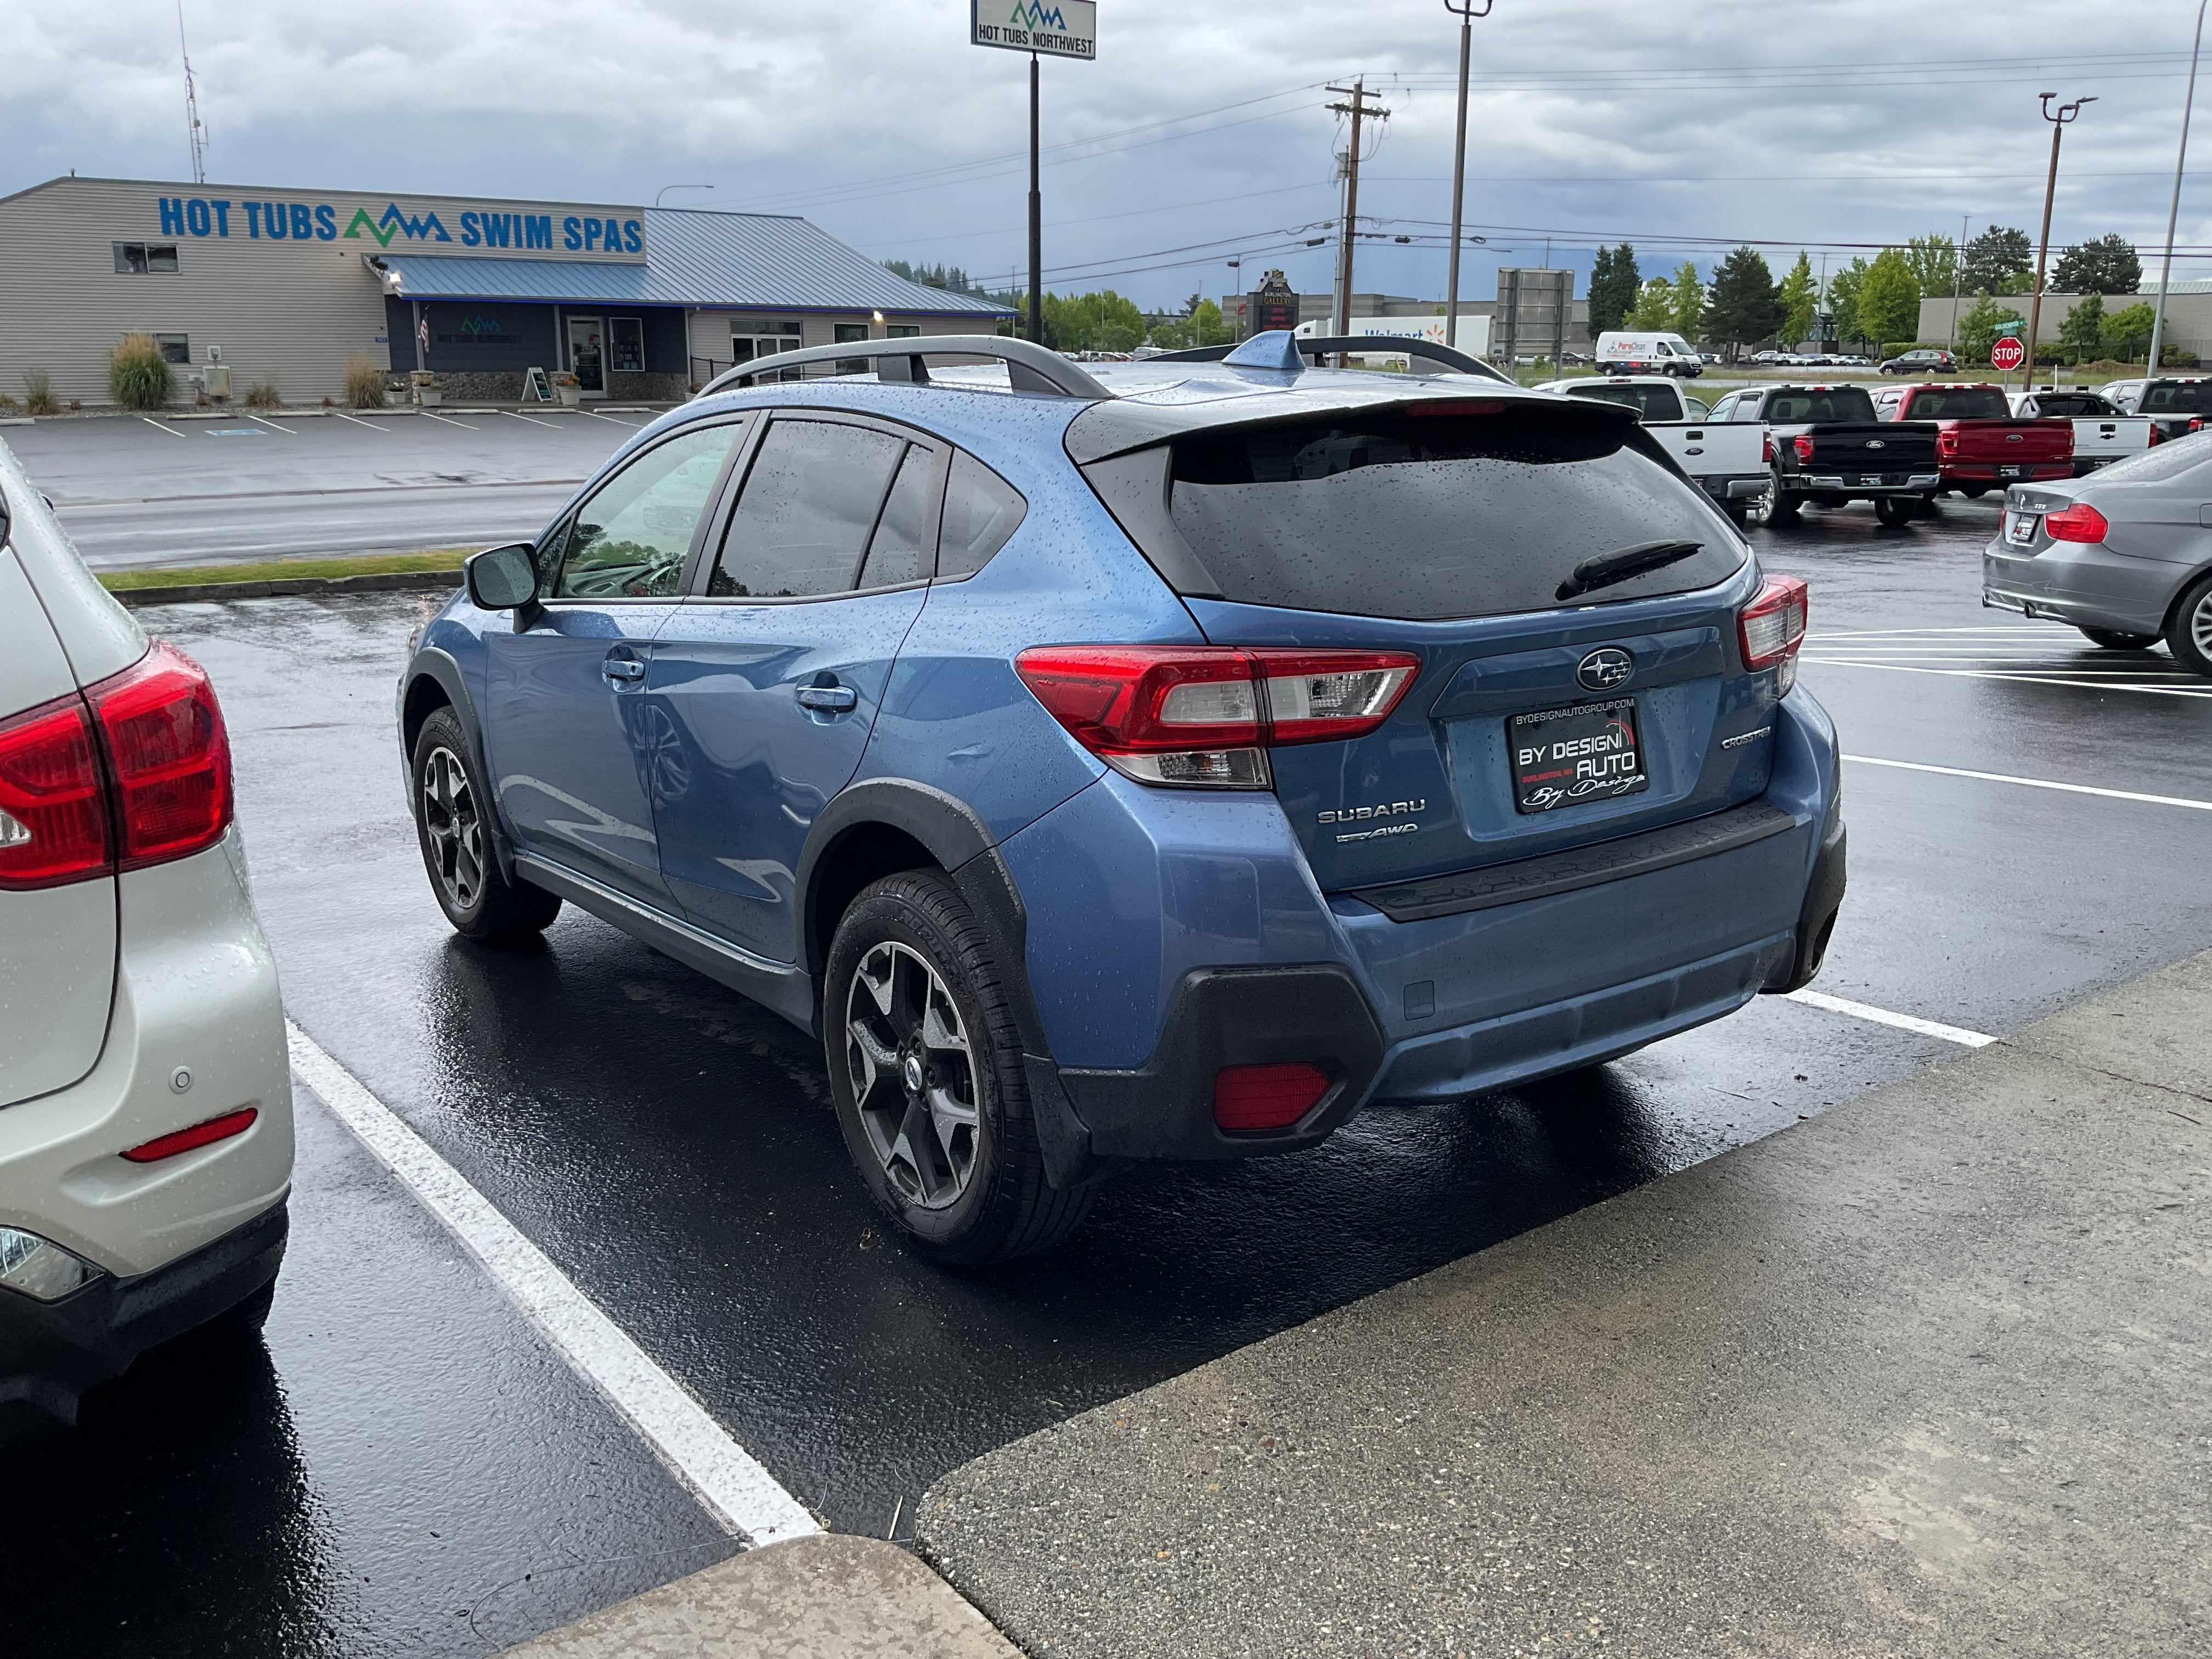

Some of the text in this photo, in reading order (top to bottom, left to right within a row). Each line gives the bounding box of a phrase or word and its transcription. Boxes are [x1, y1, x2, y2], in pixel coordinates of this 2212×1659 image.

[979, 24, 1093, 54] HOT TUBS NORTHWEST
[159, 198, 337, 241] HOT TUBS
[460, 211, 642, 253] SWIM SPAS
[1264, 297, 1290, 305] GALLERY
[1994, 348, 2021, 360] STOP
[1516, 698, 1634, 725] BYDESIGNAUTOGROUP.COM
[1519, 733, 1619, 765] BY DESIGN
[1577, 751, 1635, 780] AUTO
[1522, 773, 1645, 809] By Design
[1318, 799, 1425, 823] SUBARU
[1367, 823, 1419, 838] AWD
